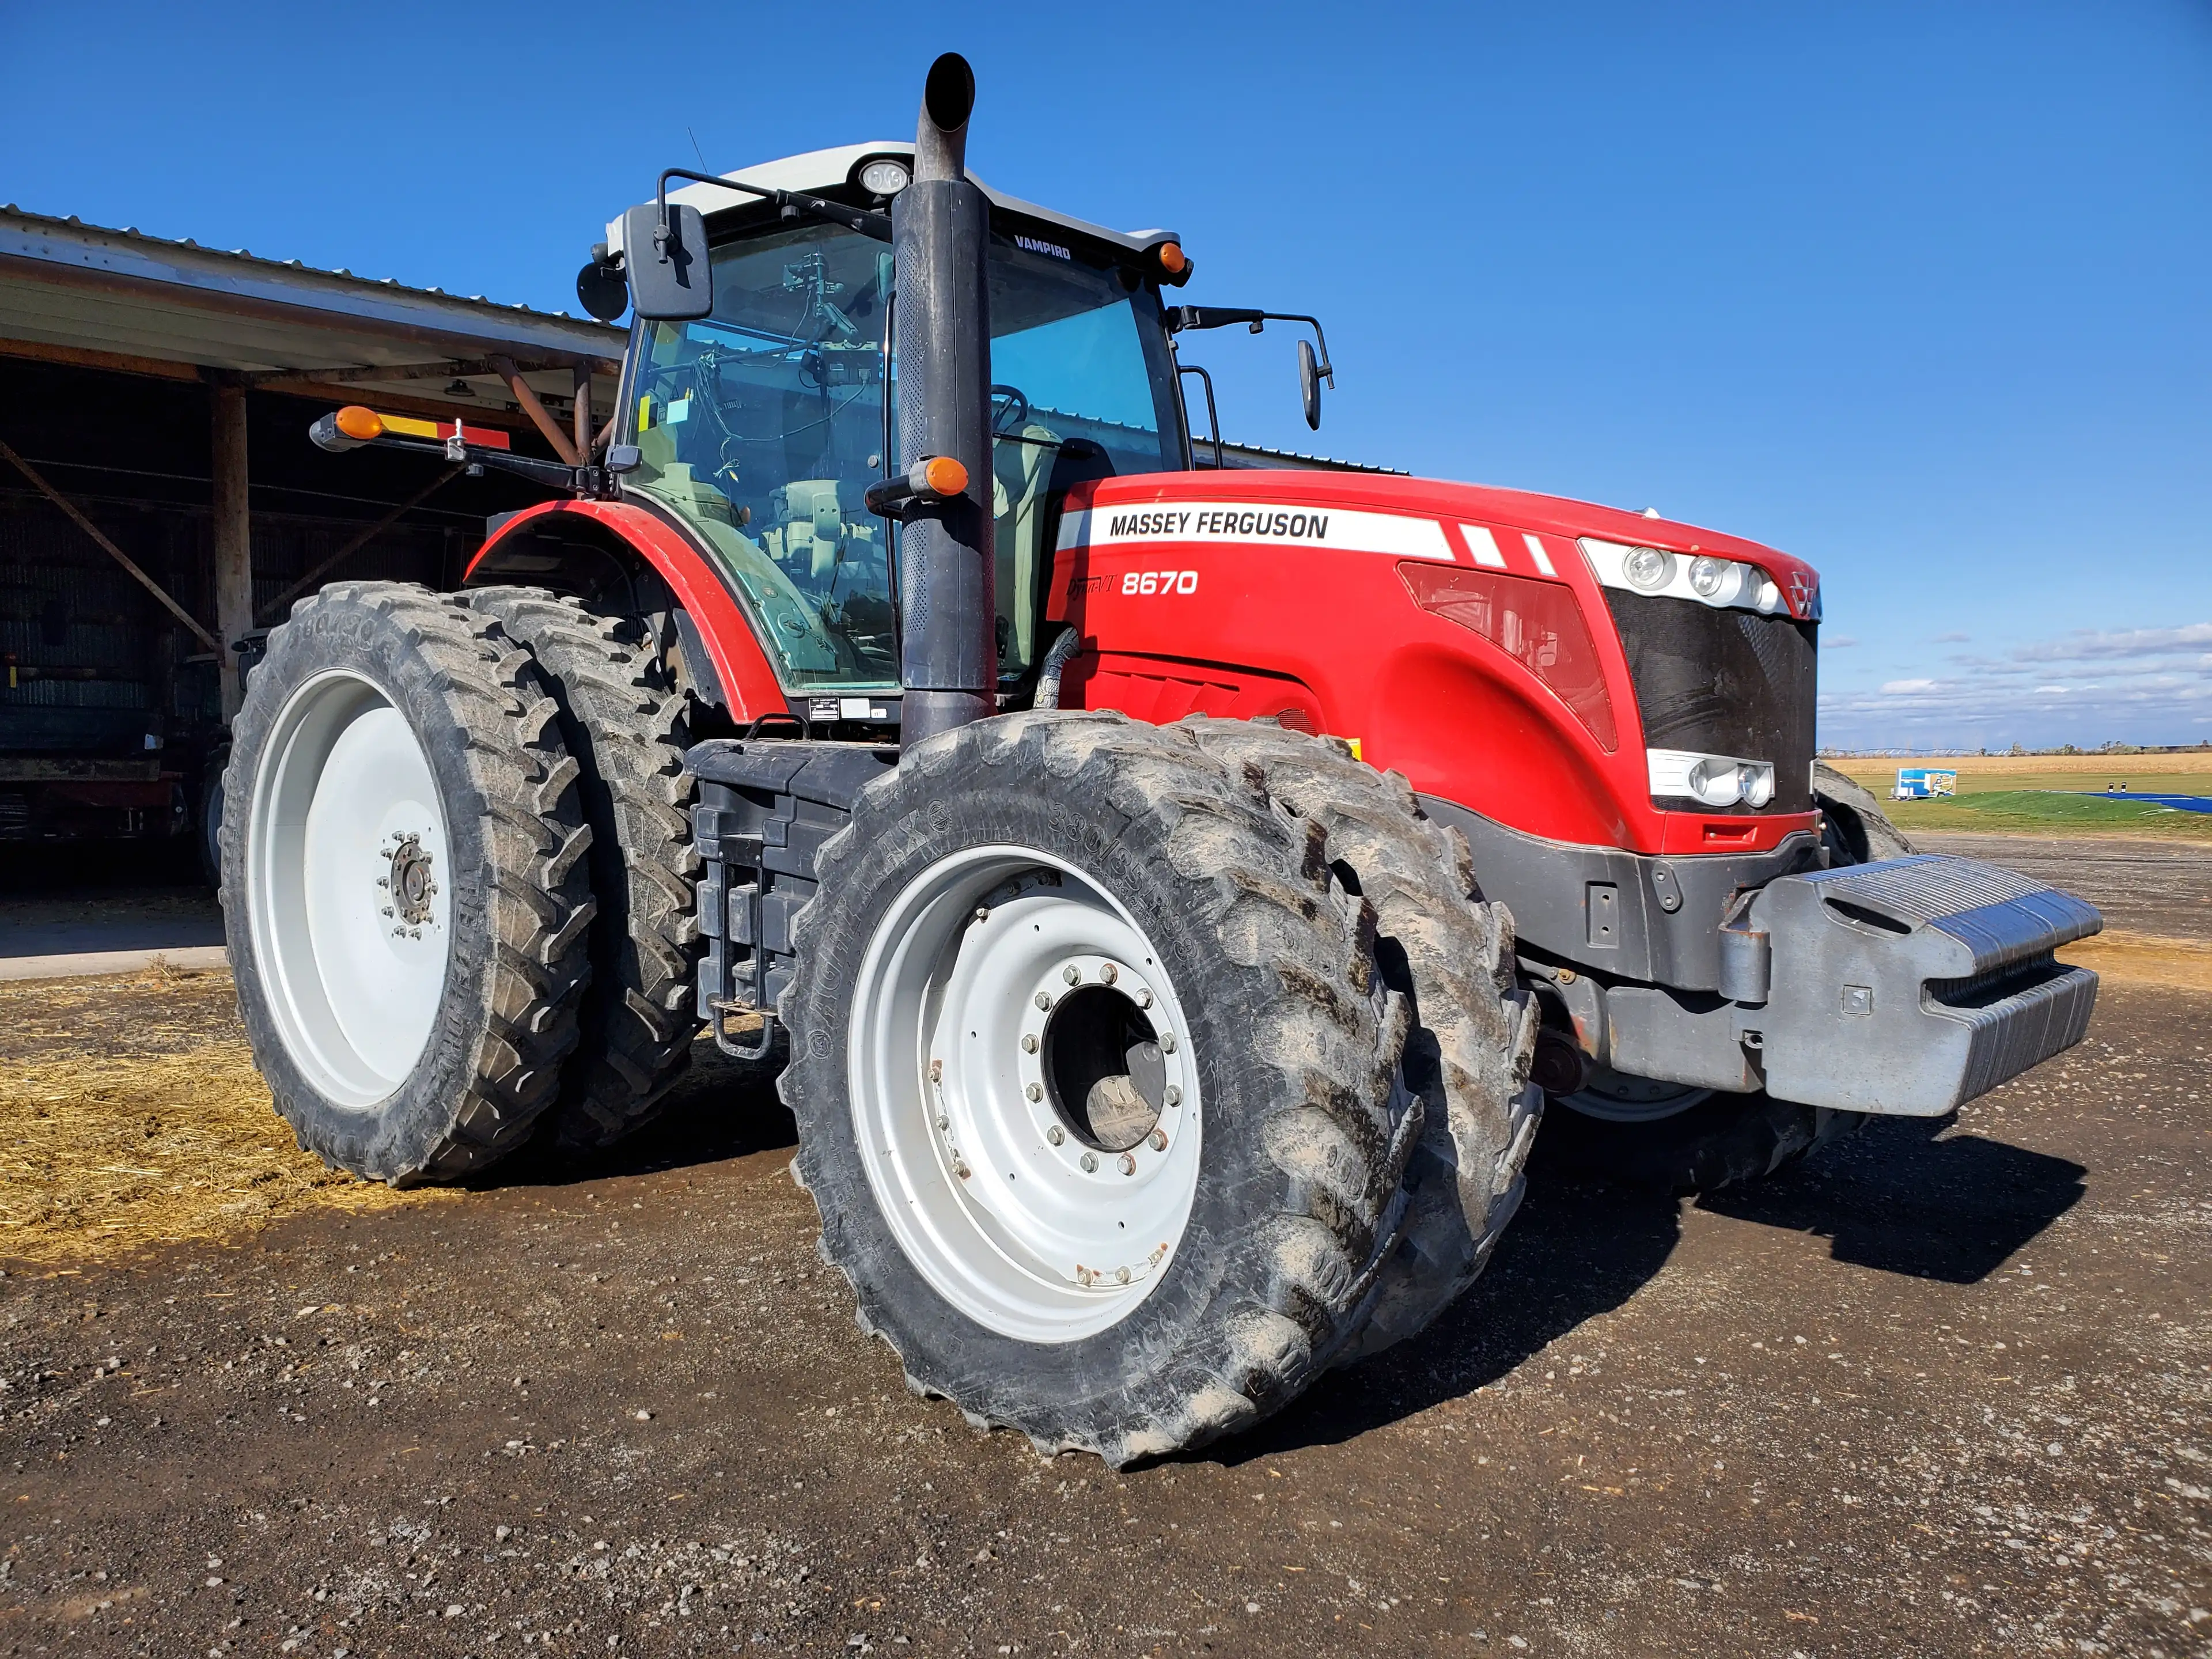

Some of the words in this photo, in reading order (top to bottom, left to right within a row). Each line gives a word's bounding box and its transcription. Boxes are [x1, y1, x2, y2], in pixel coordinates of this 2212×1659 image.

[1014, 235, 1070, 260] VAMPIRO
[1109, 512, 1192, 536] MASSEY
[1196, 511, 1329, 539] FERGUSON
[1122, 571, 1198, 595] 8670
[809, 895, 861, 1031] AGRI
[850, 808, 927, 909] MAX
